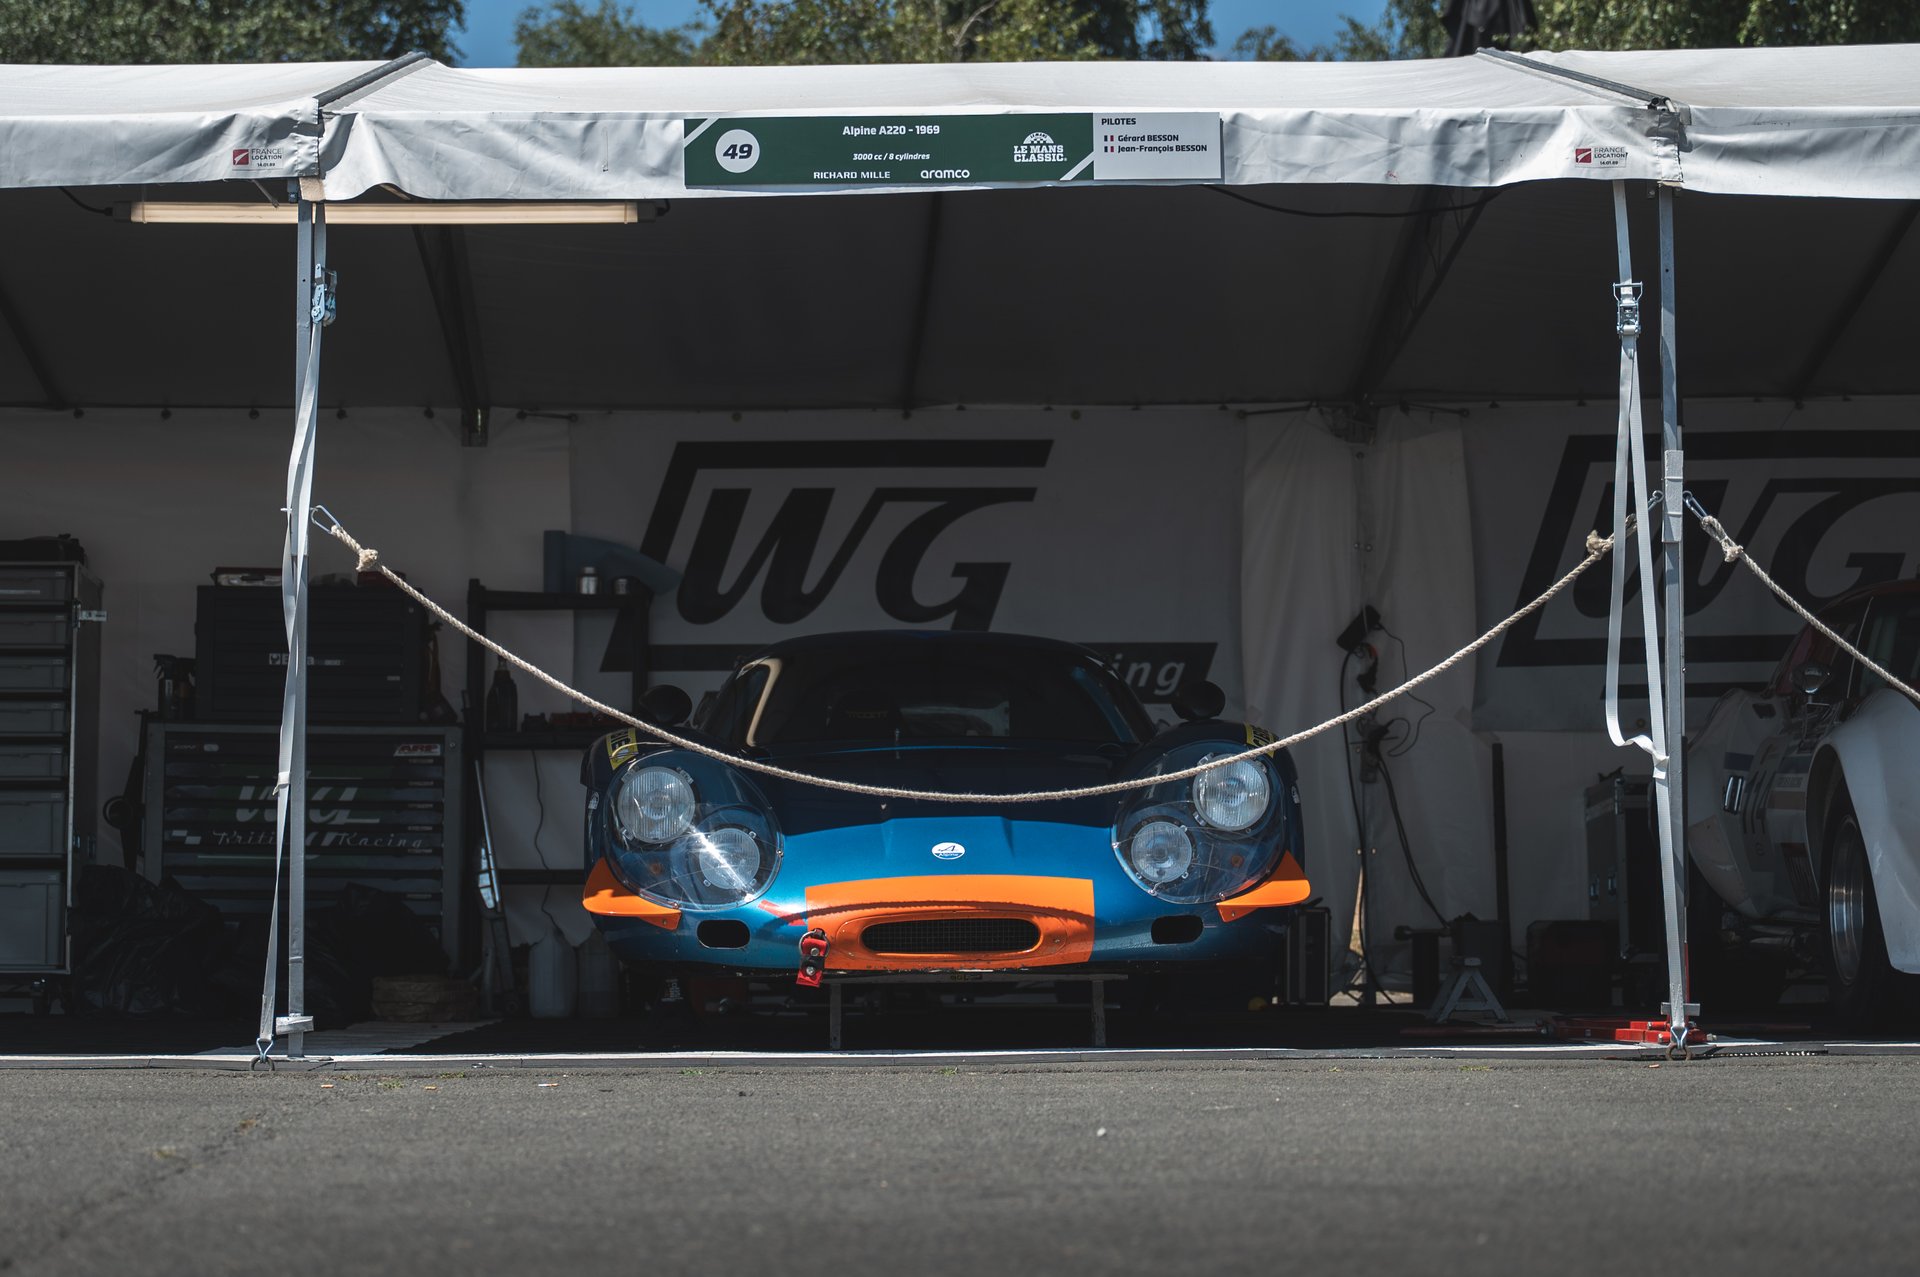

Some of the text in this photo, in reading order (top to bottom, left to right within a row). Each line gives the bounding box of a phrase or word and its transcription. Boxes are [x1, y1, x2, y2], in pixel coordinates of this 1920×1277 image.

[843, 125, 877, 137] Alpine
[879, 125, 906, 135] A220
[915, 125, 940, 134] 1969
[1118, 134, 1179, 142] Gérard BESSON
[723, 143, 753, 160] 49
[1013, 144, 1064, 154] LE MANS
[1118, 145, 1174, 154] Jean-François
[895, 153, 930, 161] cylindres
[813, 171, 891, 179] RICHARD MILLE
[920, 169, 970, 179] aramco
